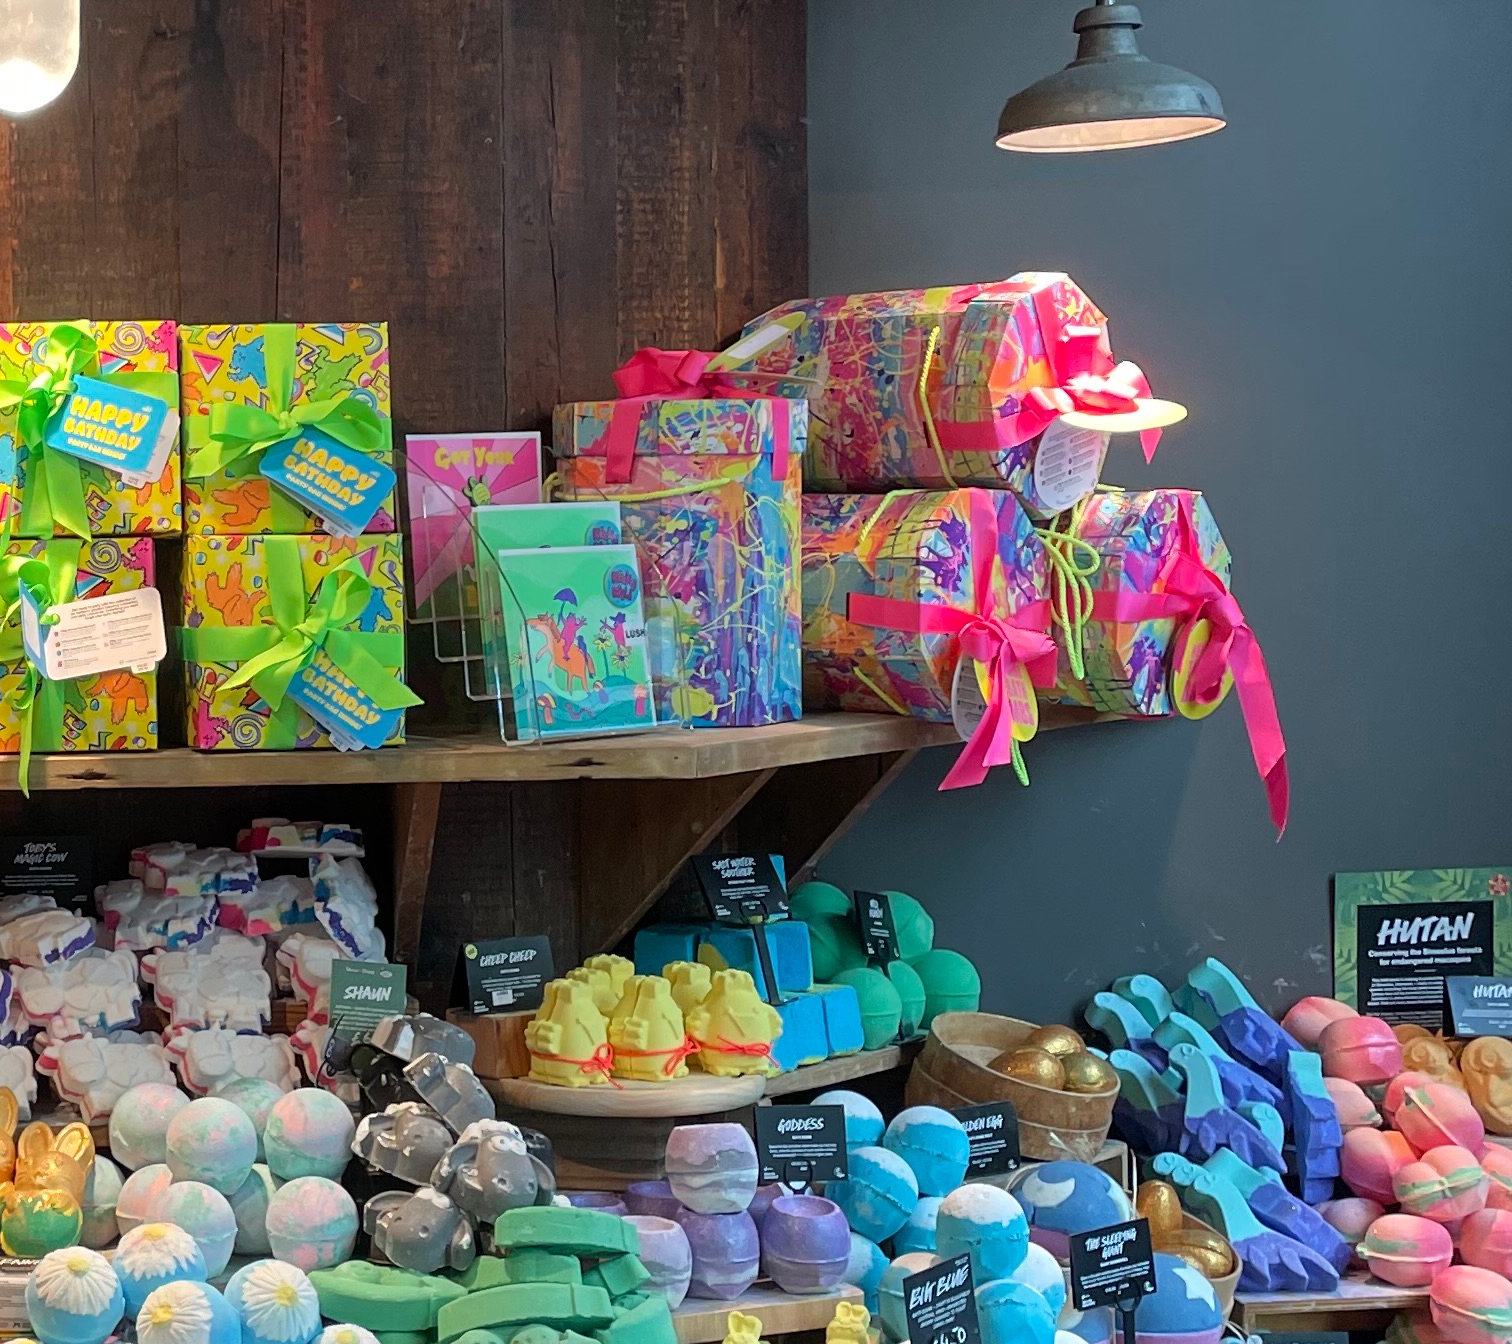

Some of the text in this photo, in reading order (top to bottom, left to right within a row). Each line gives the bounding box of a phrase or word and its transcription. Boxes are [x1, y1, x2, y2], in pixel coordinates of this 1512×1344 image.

[70, 395, 150, 433] HAPPY
[63, 417, 143, 451] BATHDAY
[283, 455, 366, 506] BATHDAY
[292, 438, 377, 491] HAPPY
[301, 667, 381, 725] BATHDAY
[46, 851, 69, 863] COW
[1376, 912, 1475, 946] HUTAN
[479, 949, 537, 968] CHEEP CHEEP
[343, 985, 392, 1002] SHAUN
[777, 1117, 825, 1134] GODDESS
[961, 1114, 1004, 1134] LDEN EGG
